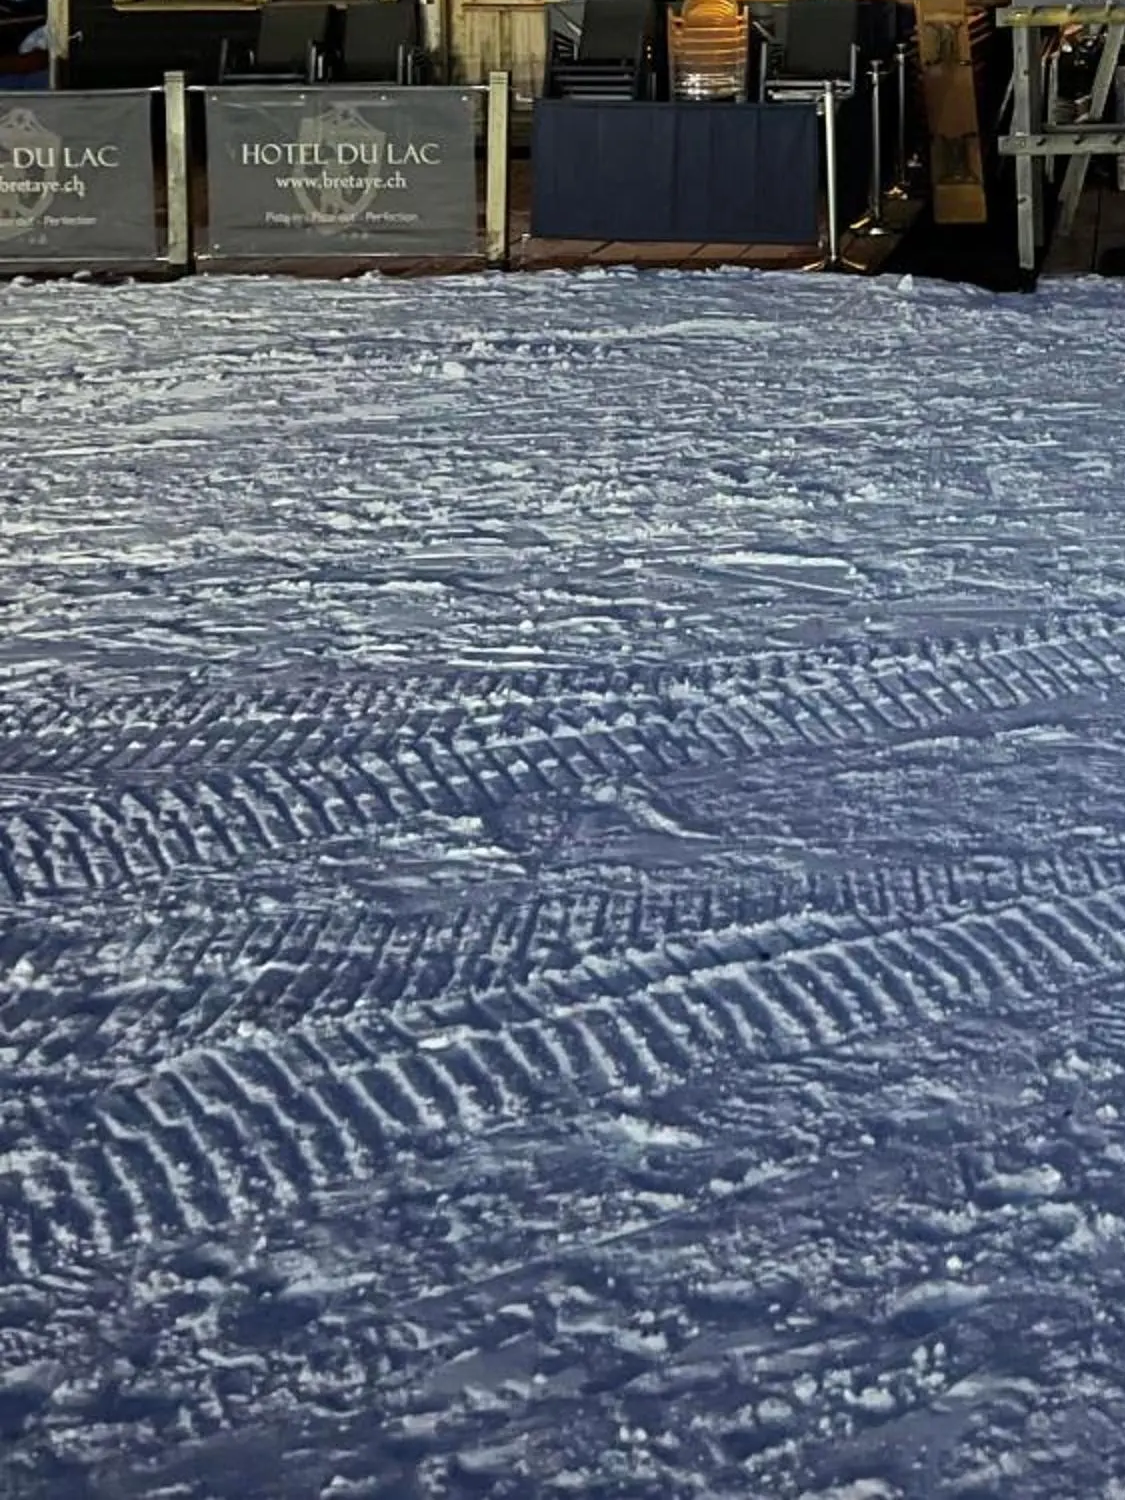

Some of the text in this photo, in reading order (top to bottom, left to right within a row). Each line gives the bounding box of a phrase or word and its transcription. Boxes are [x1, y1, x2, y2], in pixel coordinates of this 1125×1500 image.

[12, 145, 120, 169] DU LAC
[242, 143, 441, 165] HOTEL DU LAC
[0, 174, 86, 199] bretaye.ch
[275, 171, 407, 195] www.bretaye.ch
